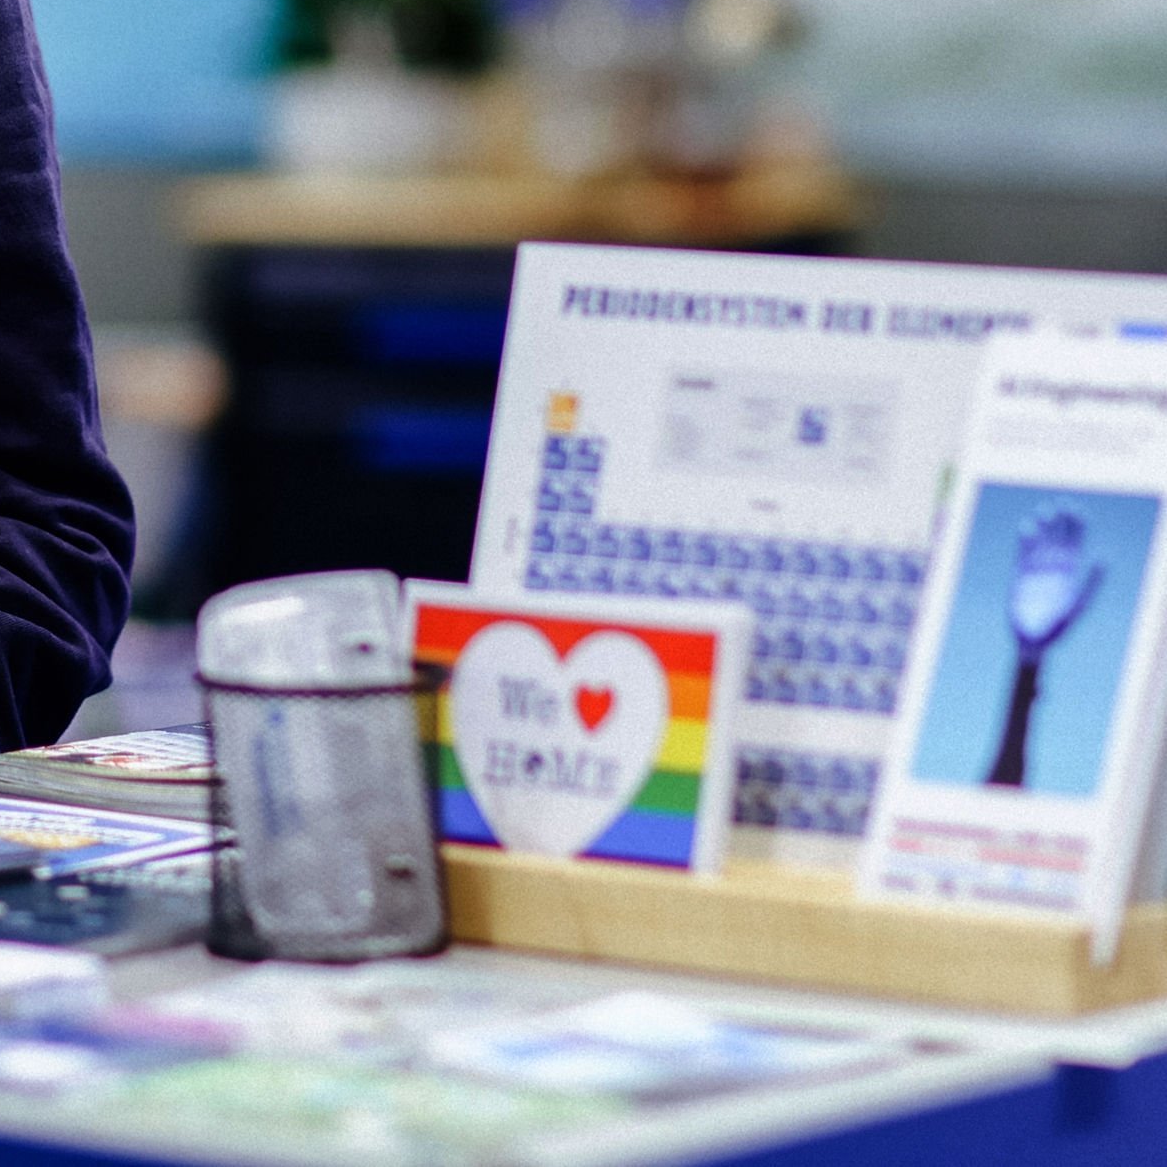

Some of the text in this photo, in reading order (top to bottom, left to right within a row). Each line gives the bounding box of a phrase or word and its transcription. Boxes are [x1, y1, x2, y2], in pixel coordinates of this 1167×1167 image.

[561, 283, 807, 330] PERIODENSYSTEM
[821, 299, 875, 335] DER
[498, 675, 560, 726] We
